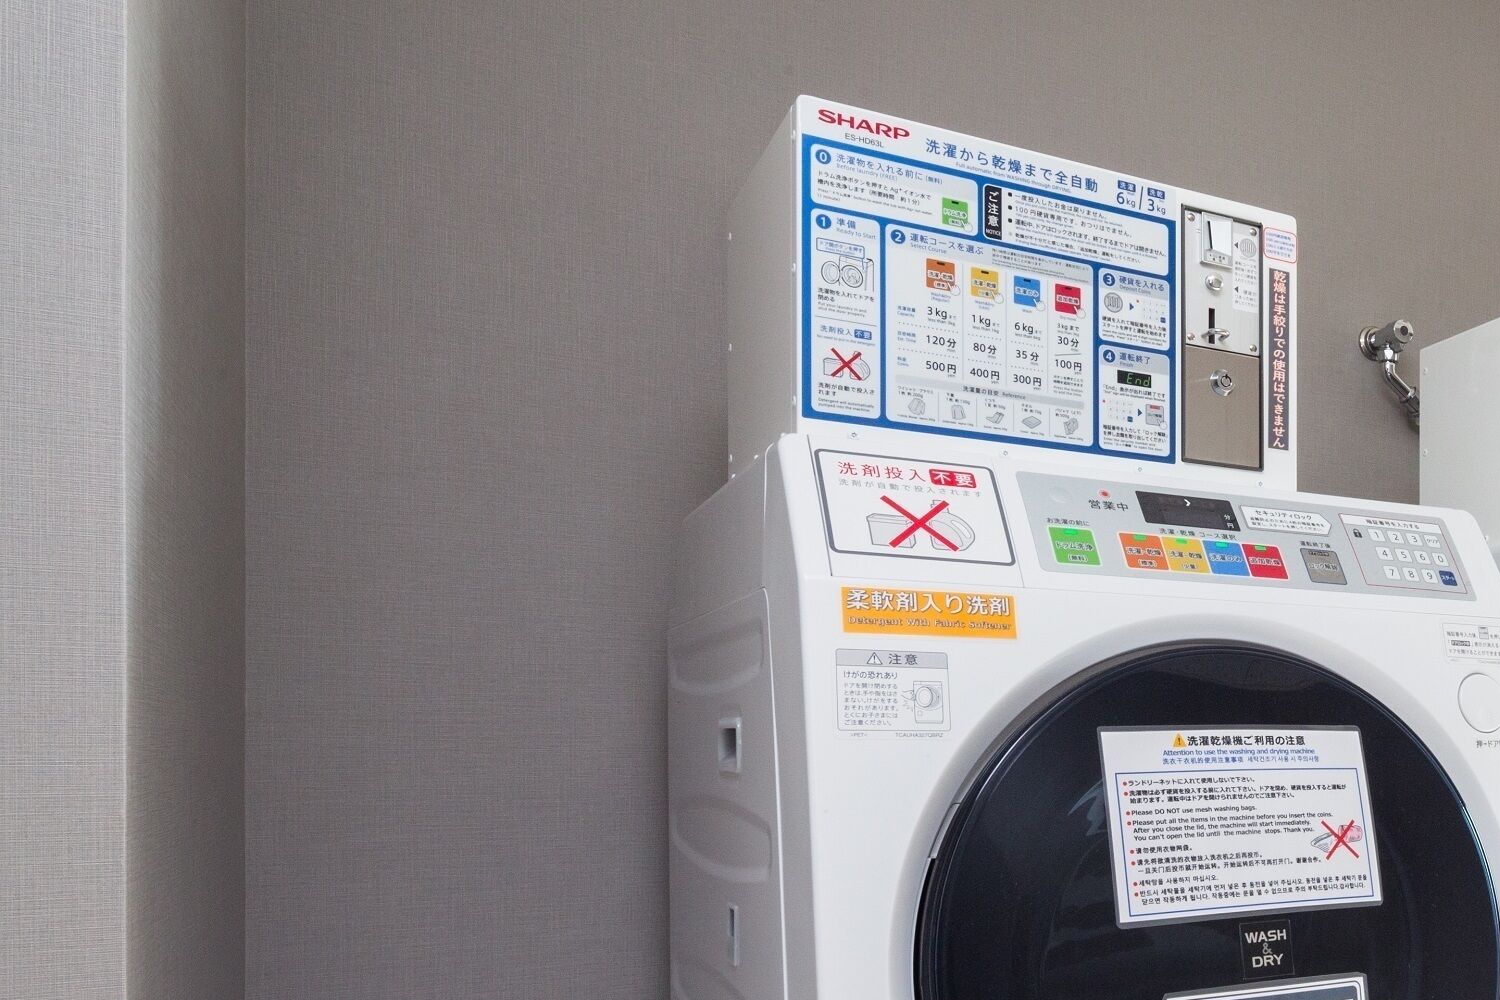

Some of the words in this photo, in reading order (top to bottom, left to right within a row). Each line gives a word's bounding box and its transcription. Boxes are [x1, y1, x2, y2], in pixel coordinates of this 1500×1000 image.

[818, 109, 910, 140] SHARP
[845, 132, 884, 149] ES-HD63L
[836, 153, 923, 181] 洗濯物を入れる前に
[925, 137, 1098, 193] 洗濯から乾燥まで全自動
[988, 191, 1000, 227] ご注意
[836, 217, 857, 230] 準備
[910, 233, 984, 256] 運転コースを選ぶ
[1119, 276, 1165, 292] 硬貨を入れる
[820, 325, 852, 337] 洗剤投入
[1119, 352, 1151, 365] 運転終了
[1273, 270, 1287, 448] 乾燥は手絞りでの使用はできません
[1126, 373, 1151, 387] End
[838, 462, 926, 483] 洗剤投入
[935, 472, 976, 487] 不要
[839, 479, 981, 498] 洗剤が自動で投入されます
[1088, 499, 1129, 512] 営業中
[1255, 509, 1313, 521] セキュリティロック
[1056, 541, 1093, 551] ドラム洗浄
[1211, 554, 1243, 563] 洗濯のみ
[847, 589, 1010, 617] 柔軟剤入り洗剤
[849, 617, 903, 627] Detergent
[907, 618, 930, 627] With
[934, 619, 966, 628] Fabric
[969, 621, 1012, 630] Softener
[889, 654, 918, 665] 注意
[844, 671, 898, 680] けがの恐れあり
[1187, 735, 1306, 747] 洗濯乾燥機ご利用の注意
[1270, 748, 1289, 756] drying
[1128, 777, 1255, 787] ランドリーネットに入れて使用しないで下さい。
[1214, 805, 1240, 813] washing
[1244, 929, 1287, 944] WASH
[1262, 943, 1273, 955] &
[1252, 954, 1285, 969] DRY
